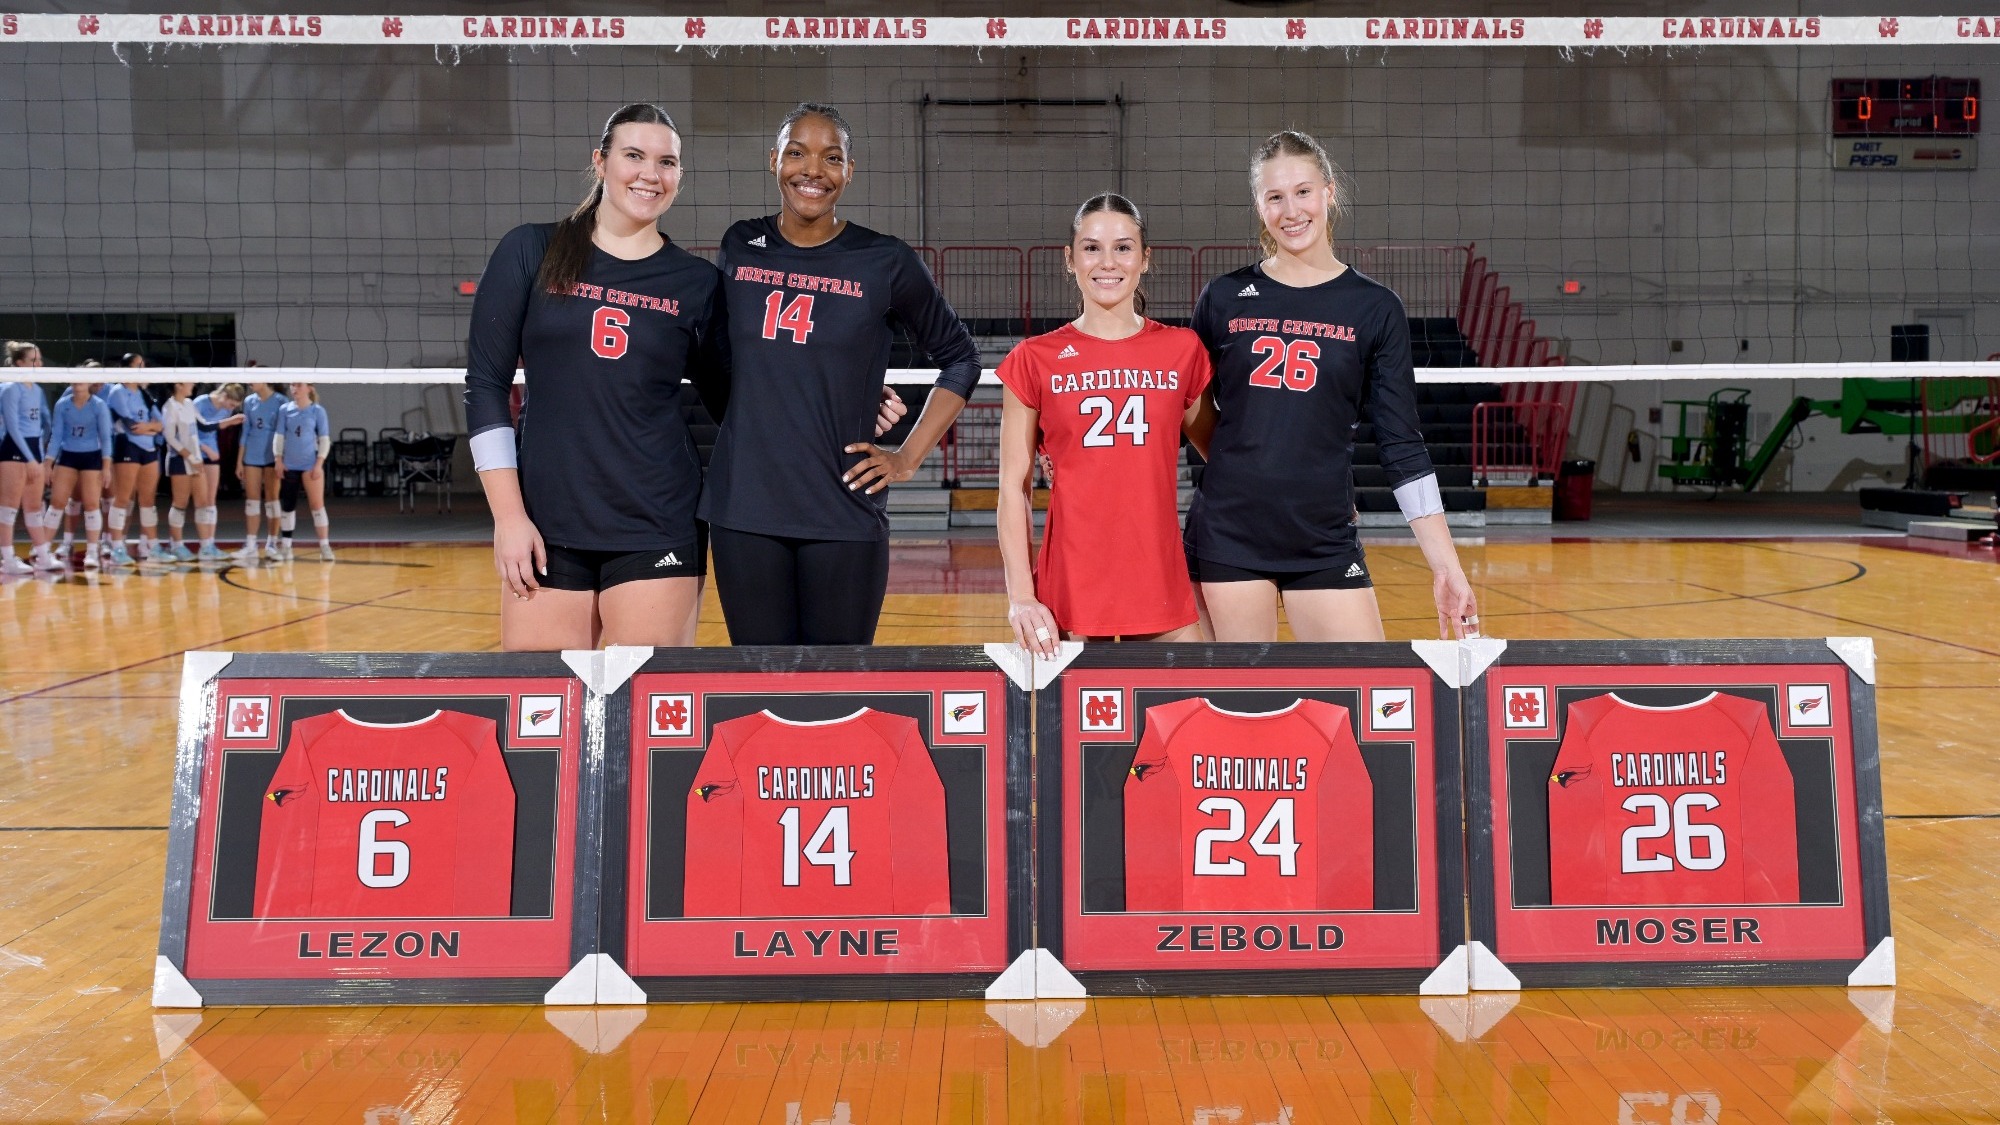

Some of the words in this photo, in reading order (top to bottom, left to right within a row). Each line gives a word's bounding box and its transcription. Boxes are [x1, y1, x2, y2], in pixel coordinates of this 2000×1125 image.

[159, 15, 322, 37] CARDINALS
[463, 16, 625, 39] CARDINALS
[765, 17, 927, 39] CARDINALS
[1066, 18, 1227, 40] CARDINALS
[1365, 18, 1525, 40] CARDINALS
[1663, 17, 1821, 39] CARDINALS
[1858, 97, 1872, 120] 0
[1963, 97, 1977, 120] 0
[1850, 155, 1898, 166] PEPSI
[1853, 142, 1882, 152] DIET
[546, 281, 604, 301] RTH
[606, 288, 680, 316] CENTRAL
[735, 266, 785, 286] NORTH
[787, 273, 863, 298] CENTRAL
[591, 305, 631, 360] 6
[762, 290, 815, 344] 14
[1228, 317, 1280, 334] NORTH
[1281, 319, 1356, 342] CENTRAL
[1050, 369, 1179, 394] CARDINALS
[1248, 335, 1321, 393] 26
[1078, 394, 1150, 448] 24
[327, 767, 449, 803] CARDINALS
[757, 764, 875, 800] CARDINALS
[1192, 754, 1308, 791] CARDINALS
[1610, 751, 1727, 787] CARDINALS
[356, 808, 411, 889] 6
[777, 805, 857, 887] 14
[1192, 796, 1302, 877] 24
[1620, 791, 1727, 874] 26
[297, 930, 461, 959] LEZON
[733, 928, 900, 958] LAYNE
[1156, 924, 1345, 952] ZEBOLD
[1595, 917, 1763, 945] MOSER
